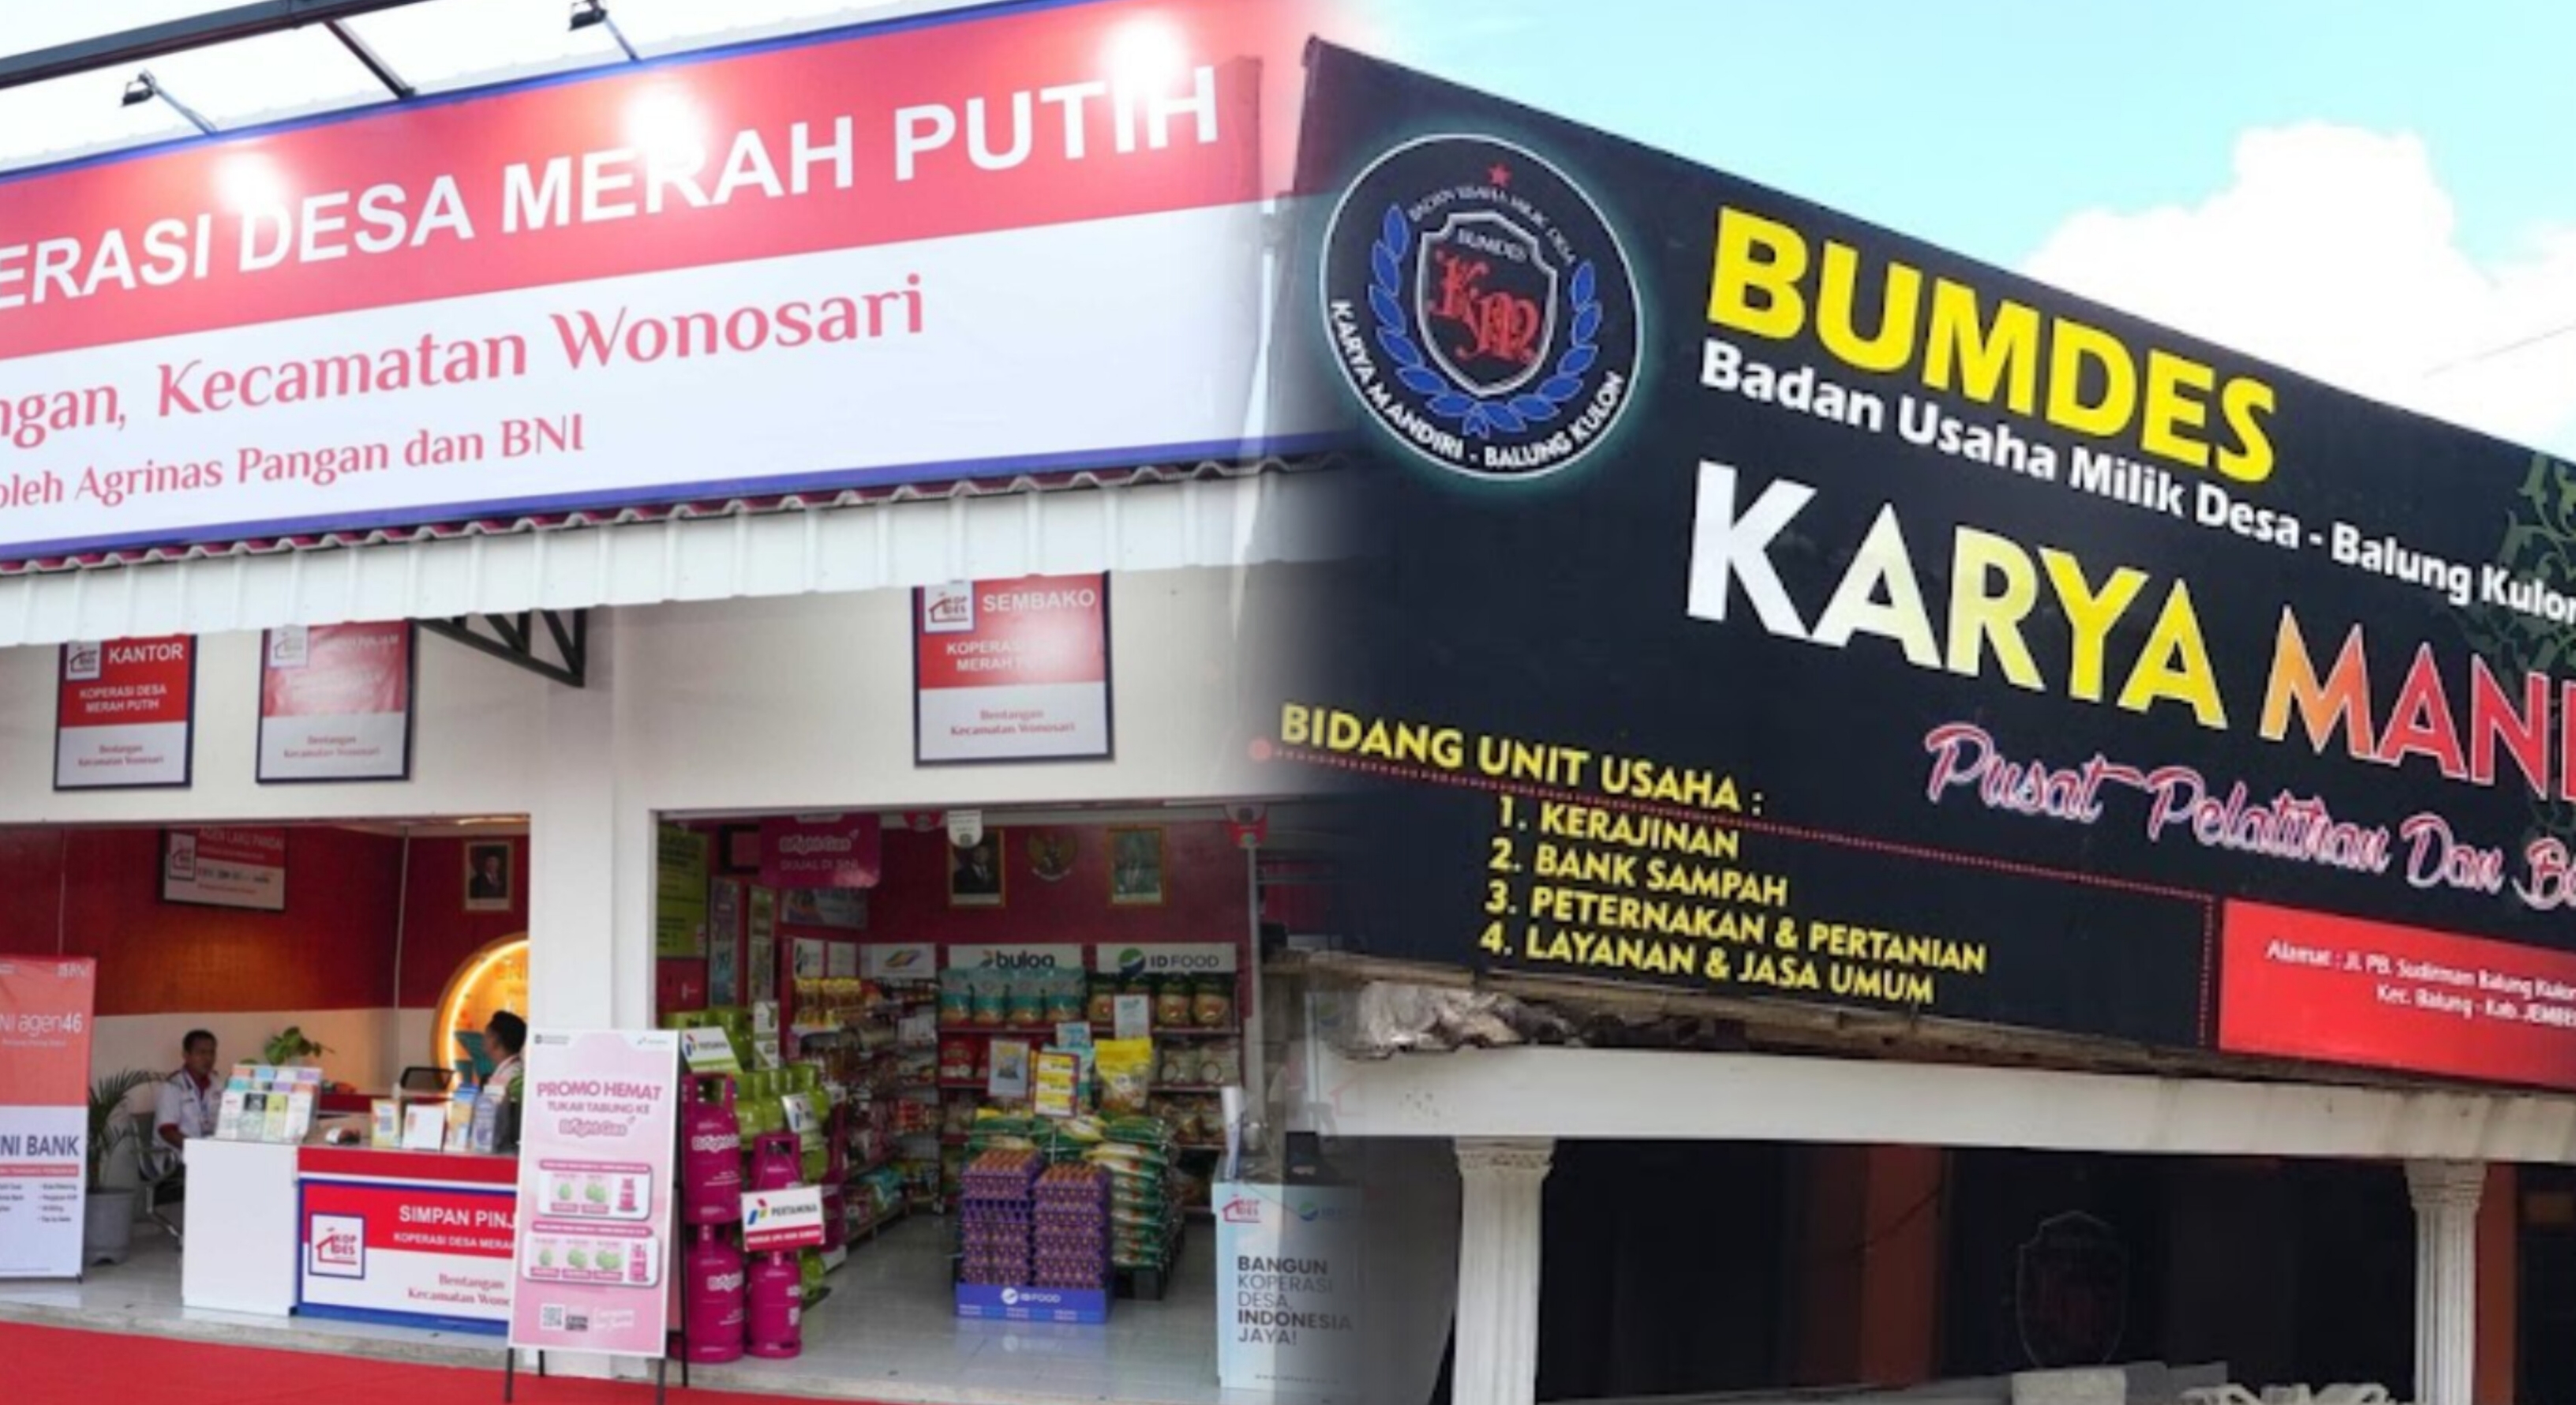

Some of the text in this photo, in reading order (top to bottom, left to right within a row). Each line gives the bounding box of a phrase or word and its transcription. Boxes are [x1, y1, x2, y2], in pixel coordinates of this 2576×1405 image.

[239, 175, 475, 272] DESA
[503, 117, 853, 234] MERAH
[895, 66, 1219, 182] PUTIH
[1457, 229, 1526, 262] BUMDES
[157, 331, 527, 418] Kecamatan
[550, 274, 924, 369] Wonosari
[1708, 207, 2277, 482] BUMDES
[1331, 300, 1380, 388] KARYA
[1369, 382, 1464, 460] MANDIRI
[1485, 430, 1572, 468] BALUNG
[1569, 369, 1626, 444] KULON
[75, 459, 223, 507] Agrinas
[238, 441, 389, 486] Pangan
[404, 430, 484, 466] dan
[500, 414, 584, 458] BNI
[1701, 339, 1885, 432] Badan
[1899, 396, 2055, 480] Usaha
[2070, 447, 2186, 519] Milik
[2196, 483, 2301, 549] Desa
[2332, 522, 2472, 607] Balung
[983, 589, 1096, 613] SEMBAKO
[1687, 460, 2228, 731] KARYA
[108, 643, 184, 665] KANTOR
[956, 657, 1013, 672] MERAH
[80, 683, 168, 699] KOPERASI DESA
[85, 697, 159, 714] MERAH PUTIH
[1280, 703, 1465, 770] BIDANG
[1478, 735, 1591, 786] UNIT
[1601, 755, 1743, 814] USAHA
[1926, 722, 2145, 824] Pusat
[1500, 795, 1739, 860] 1. KERAJINAN
[1489, 837, 1788, 909] 2. BANK SAMPAH
[1485, 881, 1987, 975] 3. PETERNAKAN & PERTANIAN
[1151, 954, 1219, 969] ID FOOD
[1480, 921, 1937, 1006] 4. LAYANAN & JASA UMUM
[2267, 939, 2331, 967] Alamat
[2397, 958, 2476, 987] Sudirman
[2478, 969, 2533, 998] Balung
[2377, 984, 2412, 1004] Kec.
[2415, 988, 2473, 1018] Balung
[537, 1080, 662, 1102] PROMO HEMAT
[548, 1100, 585, 1112] TUKAR
[586, 1101, 635, 1114] TABUNG
[26, 1134, 79, 1157] BANK
[399, 1205, 470, 1227] SIMPAN
[771, 1204, 818, 1216] PERTAMINA
[393, 1232, 447, 1246] KOPERASI
[448, 1235, 477, 1248] DESA
[1237, 1255, 1328, 1275] BANGUN
[439, 1273, 505, 1291] Bentangan
[1237, 1274, 1333, 1294] KOPERASI
[408, 1287, 476, 1304] Kecamatan
[1237, 1291, 1294, 1310] DESA,
[1237, 1309, 1354, 1332] INDONESIA
[1237, 1326, 1297, 1346] JAYA!
